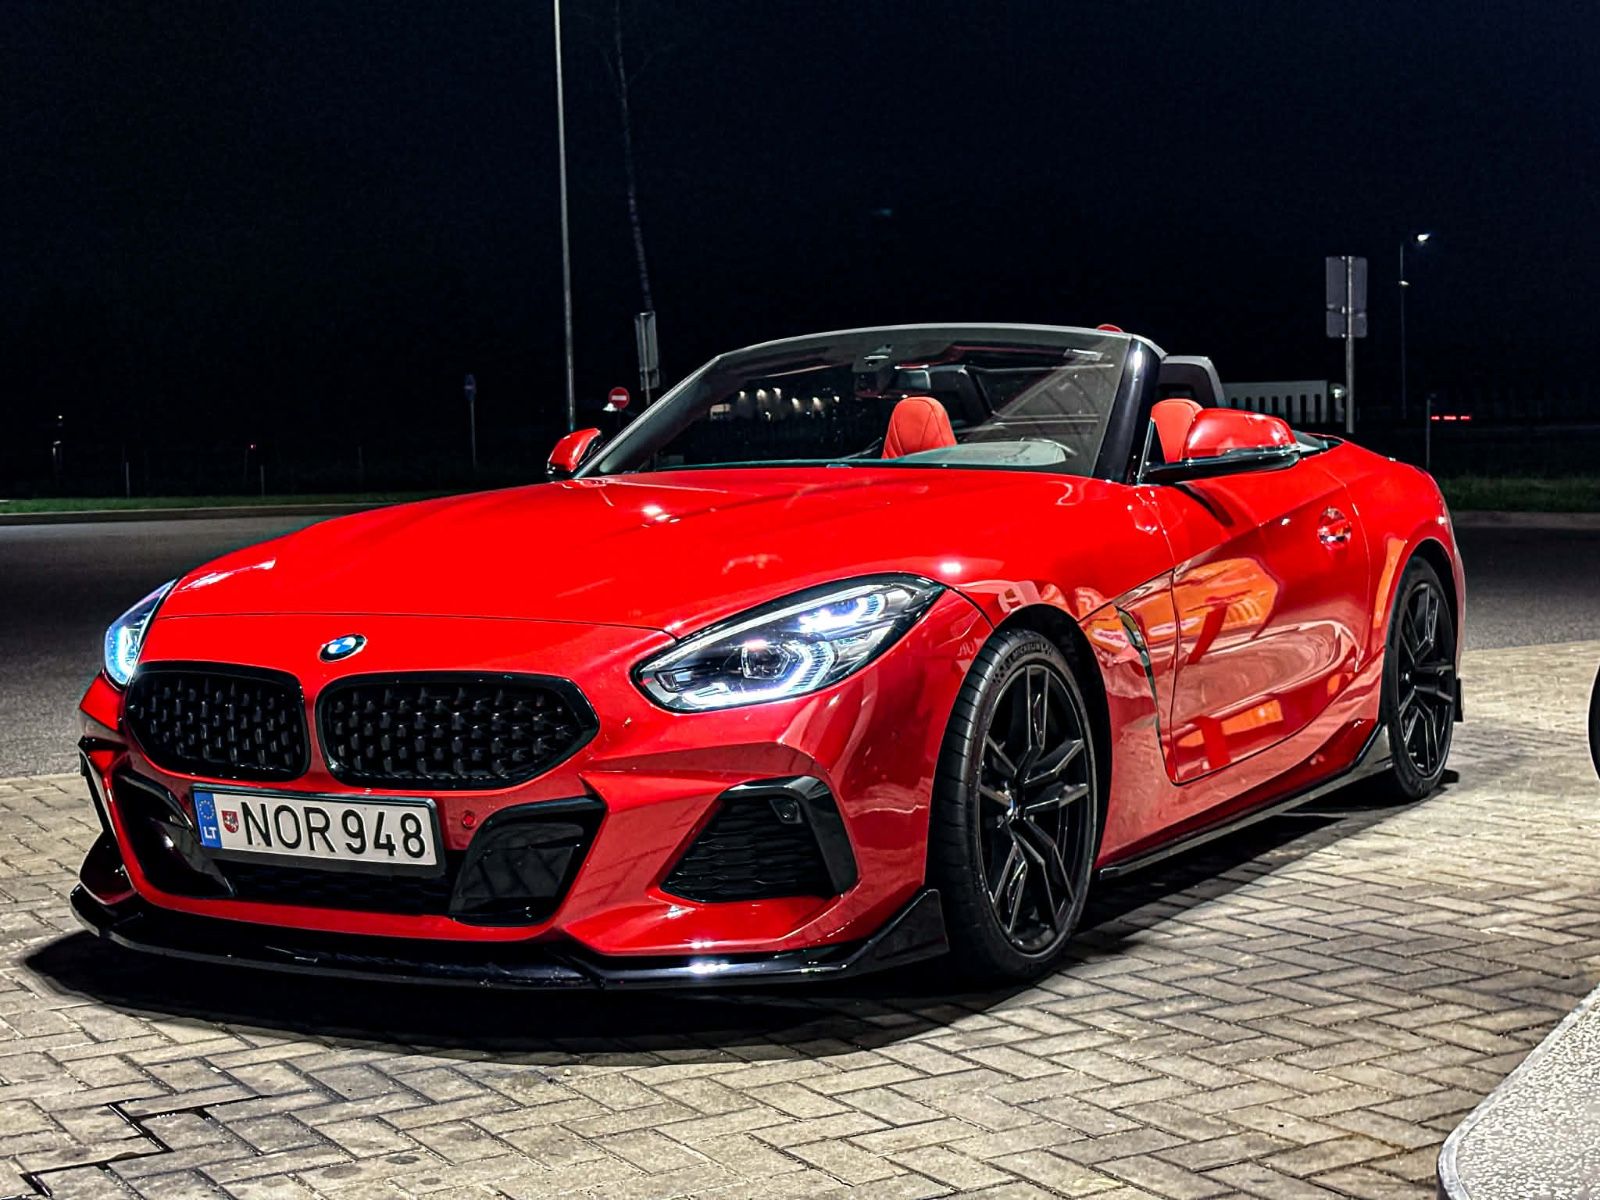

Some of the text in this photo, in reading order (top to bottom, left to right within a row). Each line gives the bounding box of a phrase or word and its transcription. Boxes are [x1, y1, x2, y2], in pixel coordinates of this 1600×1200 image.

[203, 826, 217, 839] LT
[241, 801, 426, 859] NOR 948
